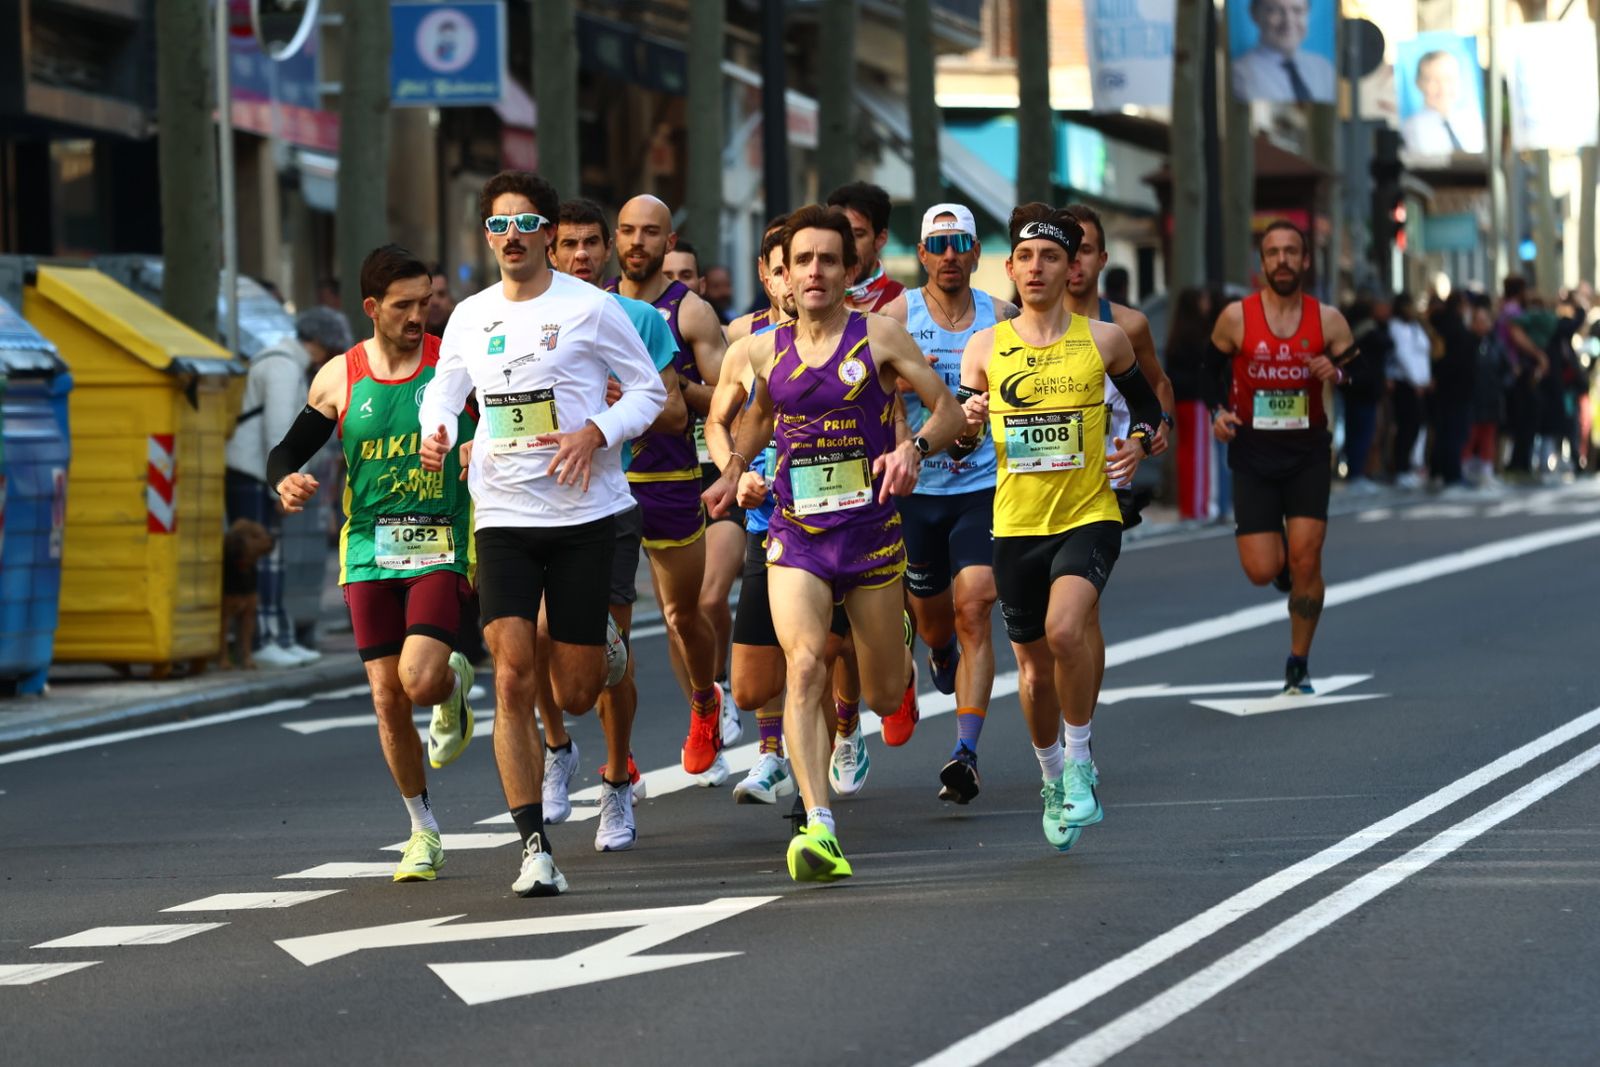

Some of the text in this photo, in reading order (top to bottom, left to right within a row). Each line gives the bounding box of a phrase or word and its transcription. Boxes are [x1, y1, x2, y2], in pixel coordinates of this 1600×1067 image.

[1037, 228, 1070, 246] MENORCA
[1034, 383, 1090, 395] MENORCA
[1268, 397, 1295, 410] 602
[511, 407, 524, 424] 3
[823, 418, 857, 432] PRIM
[816, 435, 865, 448] Macotera
[1020, 426, 1070, 444] 1008
[361, 432, 418, 460] BIKI
[822, 466, 834, 482] 7
[391, 528, 439, 543] 1052
